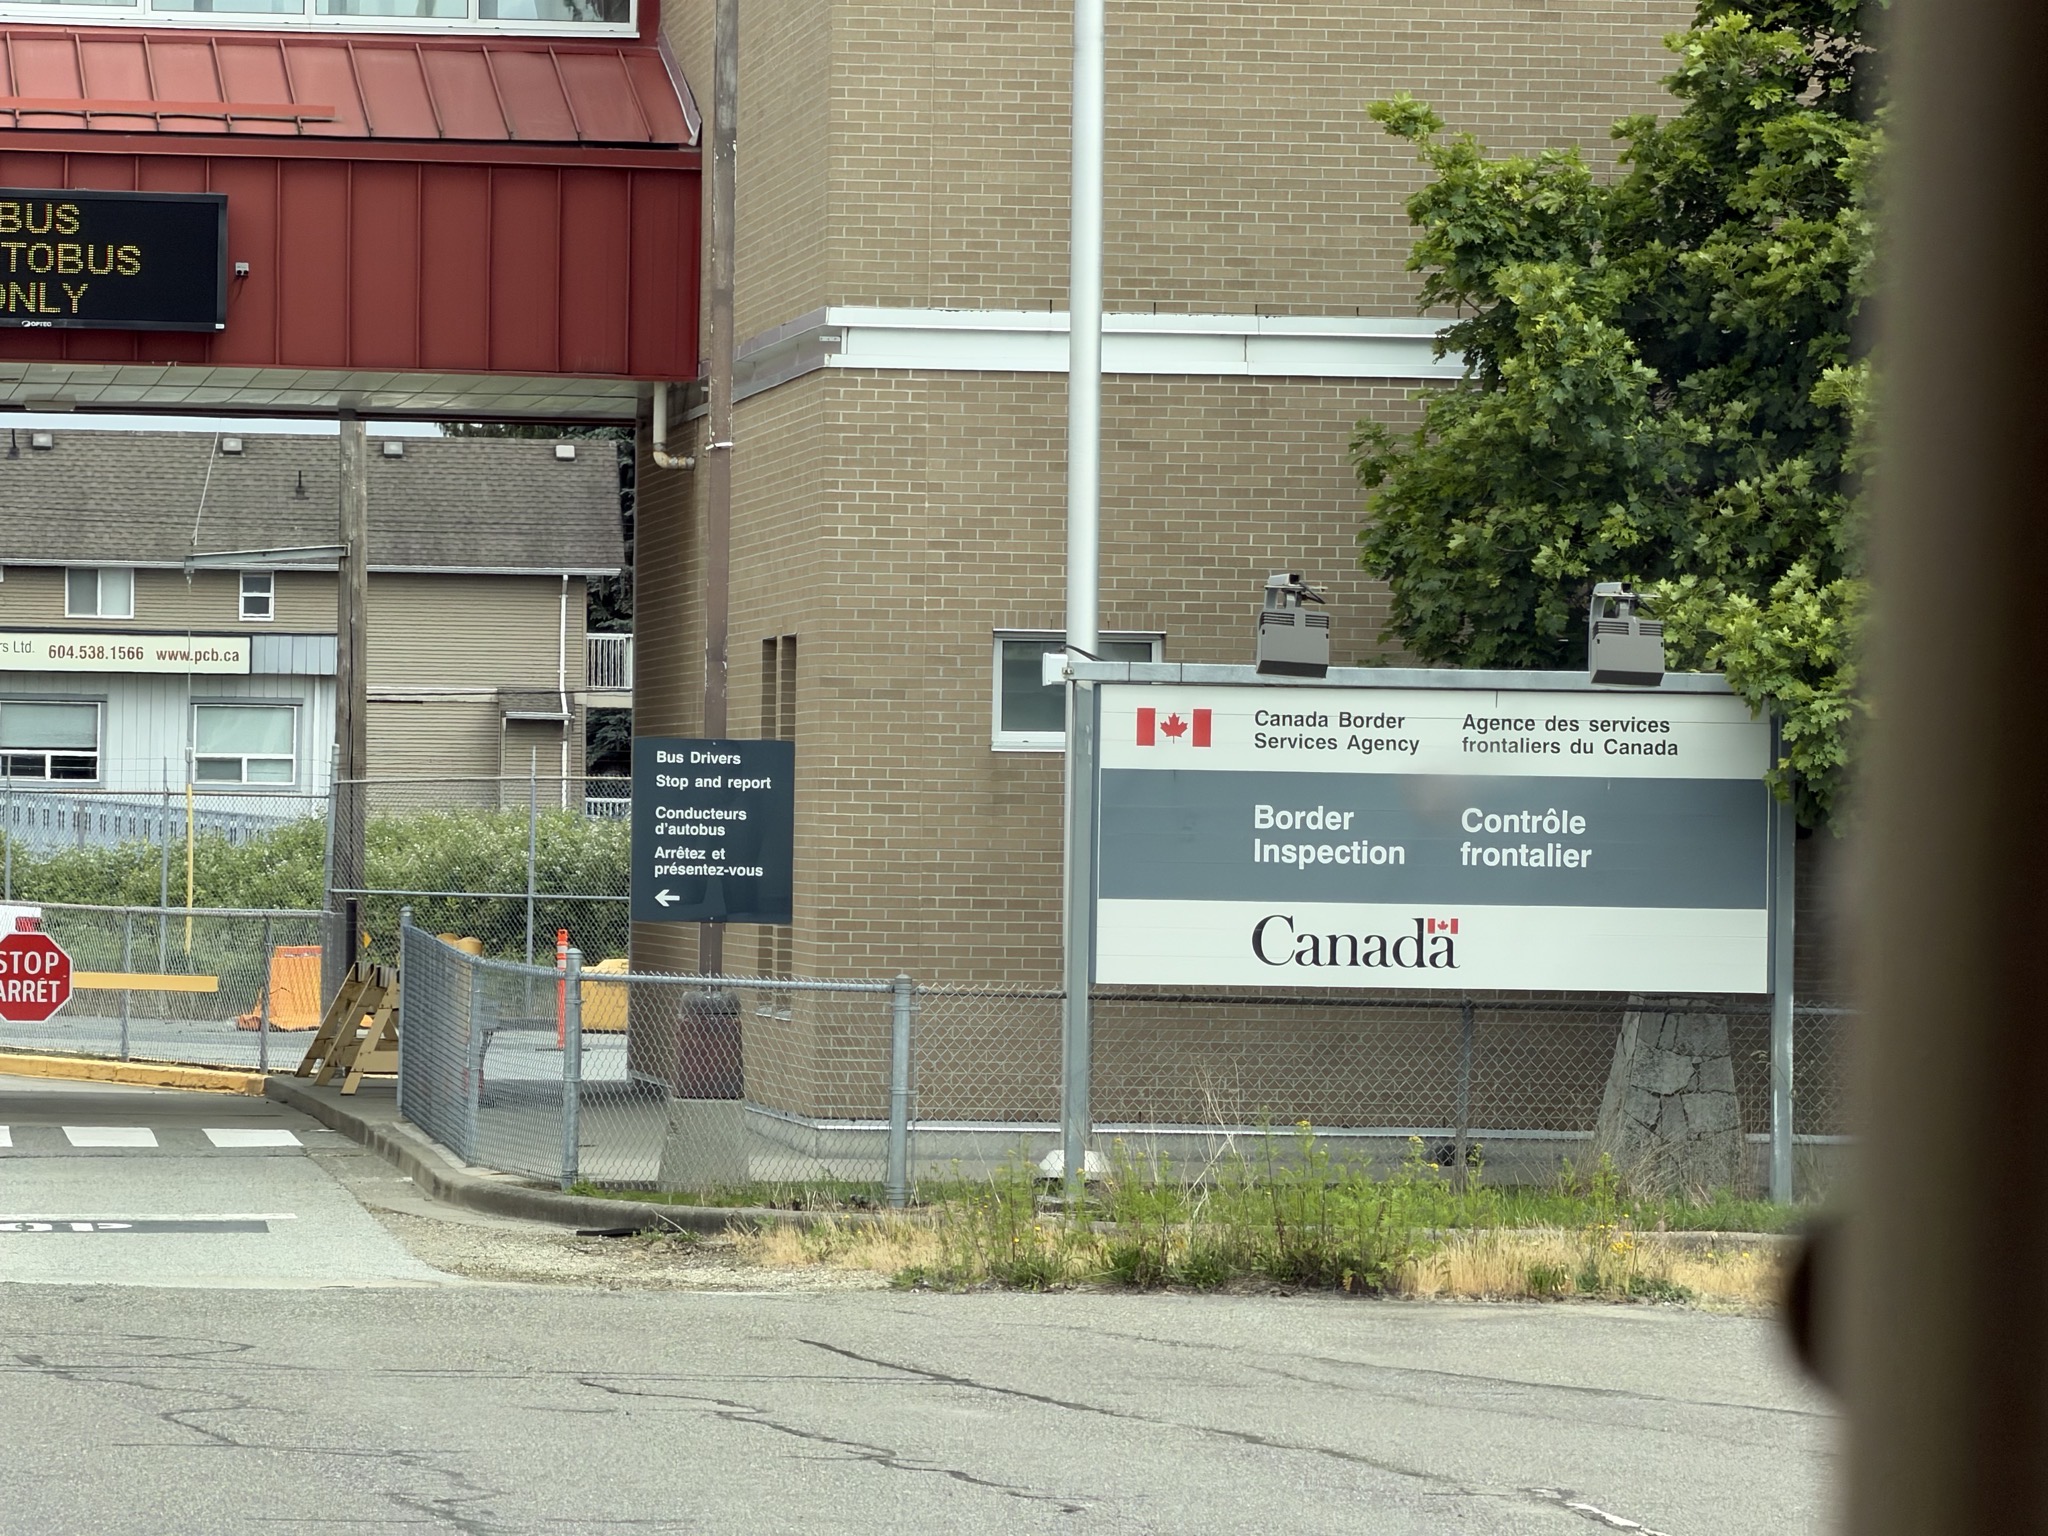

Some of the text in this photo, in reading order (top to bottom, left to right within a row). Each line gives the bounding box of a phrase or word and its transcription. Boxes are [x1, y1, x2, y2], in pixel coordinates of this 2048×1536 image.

[0, 202, 80, 235] BUS
[0, 281, 89, 314] NLY
[13, 640, 36, 654] Ltd.
[48, 644, 144, 661] 604.538.1566
[156, 647, 240, 664] www.pcb.ca
[1253, 709, 1406, 730] Canada Border
[1461, 713, 1671, 737] Agence des services
[1253, 732, 1421, 757] Services Agency
[1461, 736, 1680, 757] frontaliers du Canada
[656, 750, 742, 765] Bus Drivers
[655, 774, 772, 792] Stop and report
[655, 805, 748, 821] Conducteurs
[1253, 803, 1355, 832] Border
[1460, 806, 1587, 835] Contrôle
[654, 822, 726, 837] d'autobus
[654, 845, 726, 861] Arrêtez et
[1253, 838, 1406, 870] Inspection
[1459, 841, 1593, 869] frontalier
[654, 861, 764, 878] présentez-vous
[1251, 914, 1461, 969] Canada
